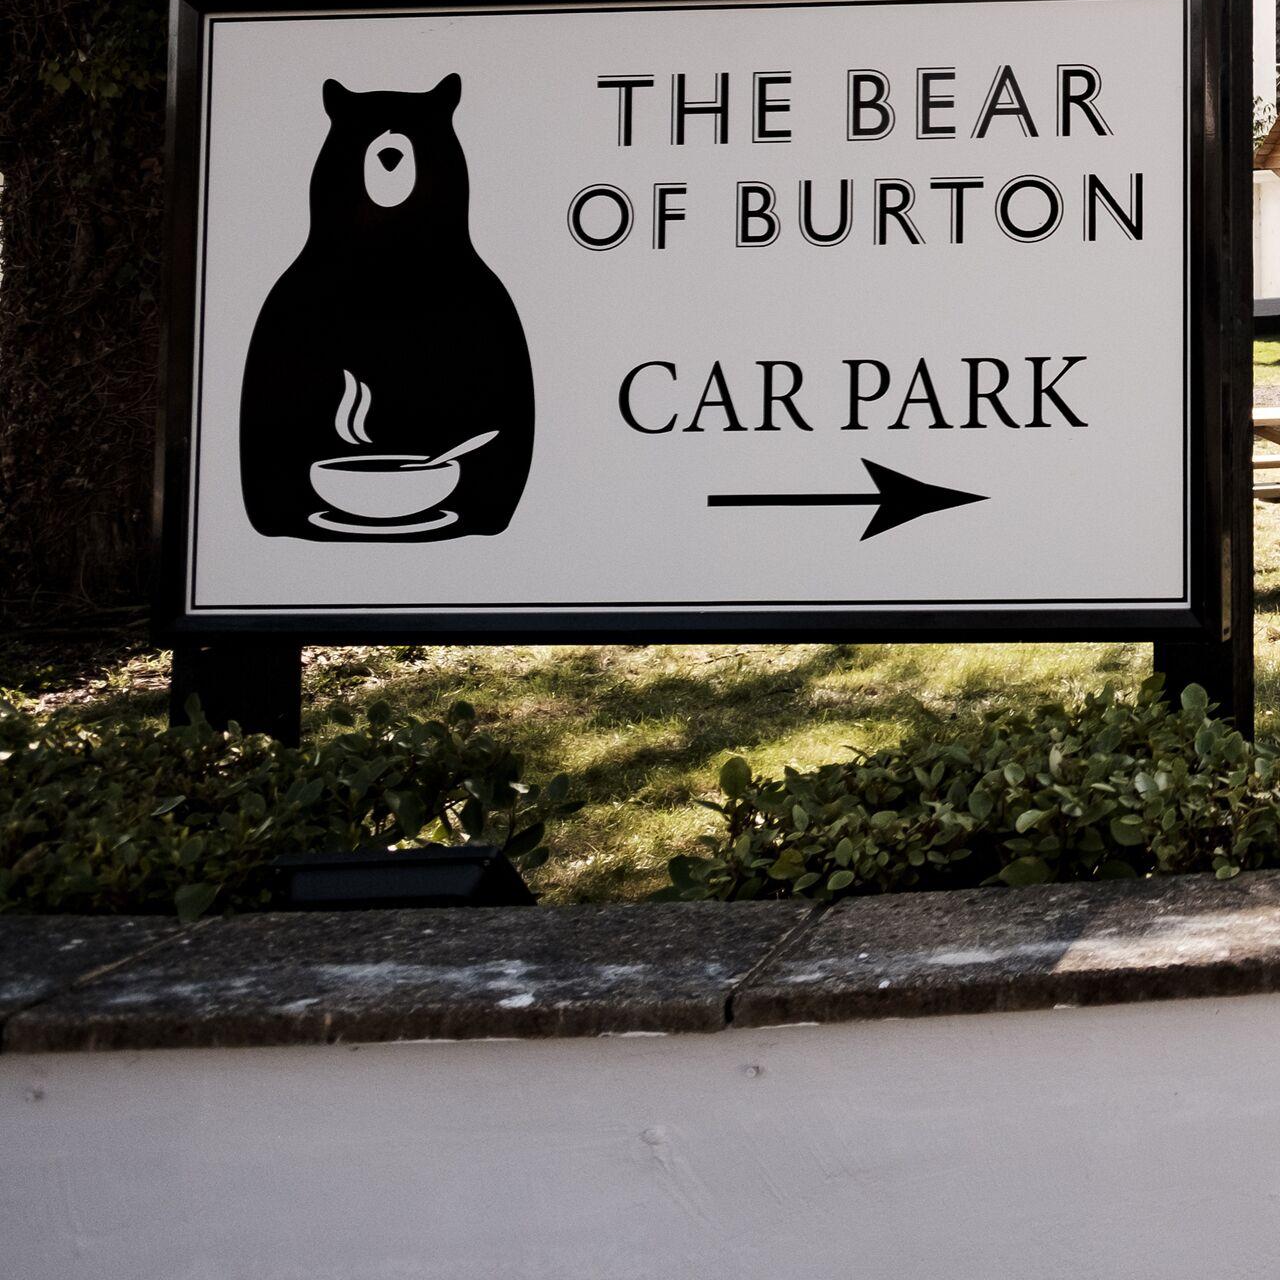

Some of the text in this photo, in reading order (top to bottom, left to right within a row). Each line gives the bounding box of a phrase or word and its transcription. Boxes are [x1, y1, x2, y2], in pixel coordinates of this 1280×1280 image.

[597, 63, 1114, 147] THE BEAR
[566, 172, 1144, 252] OF BURTON
[618, 355, 1089, 435] CAR PARK
